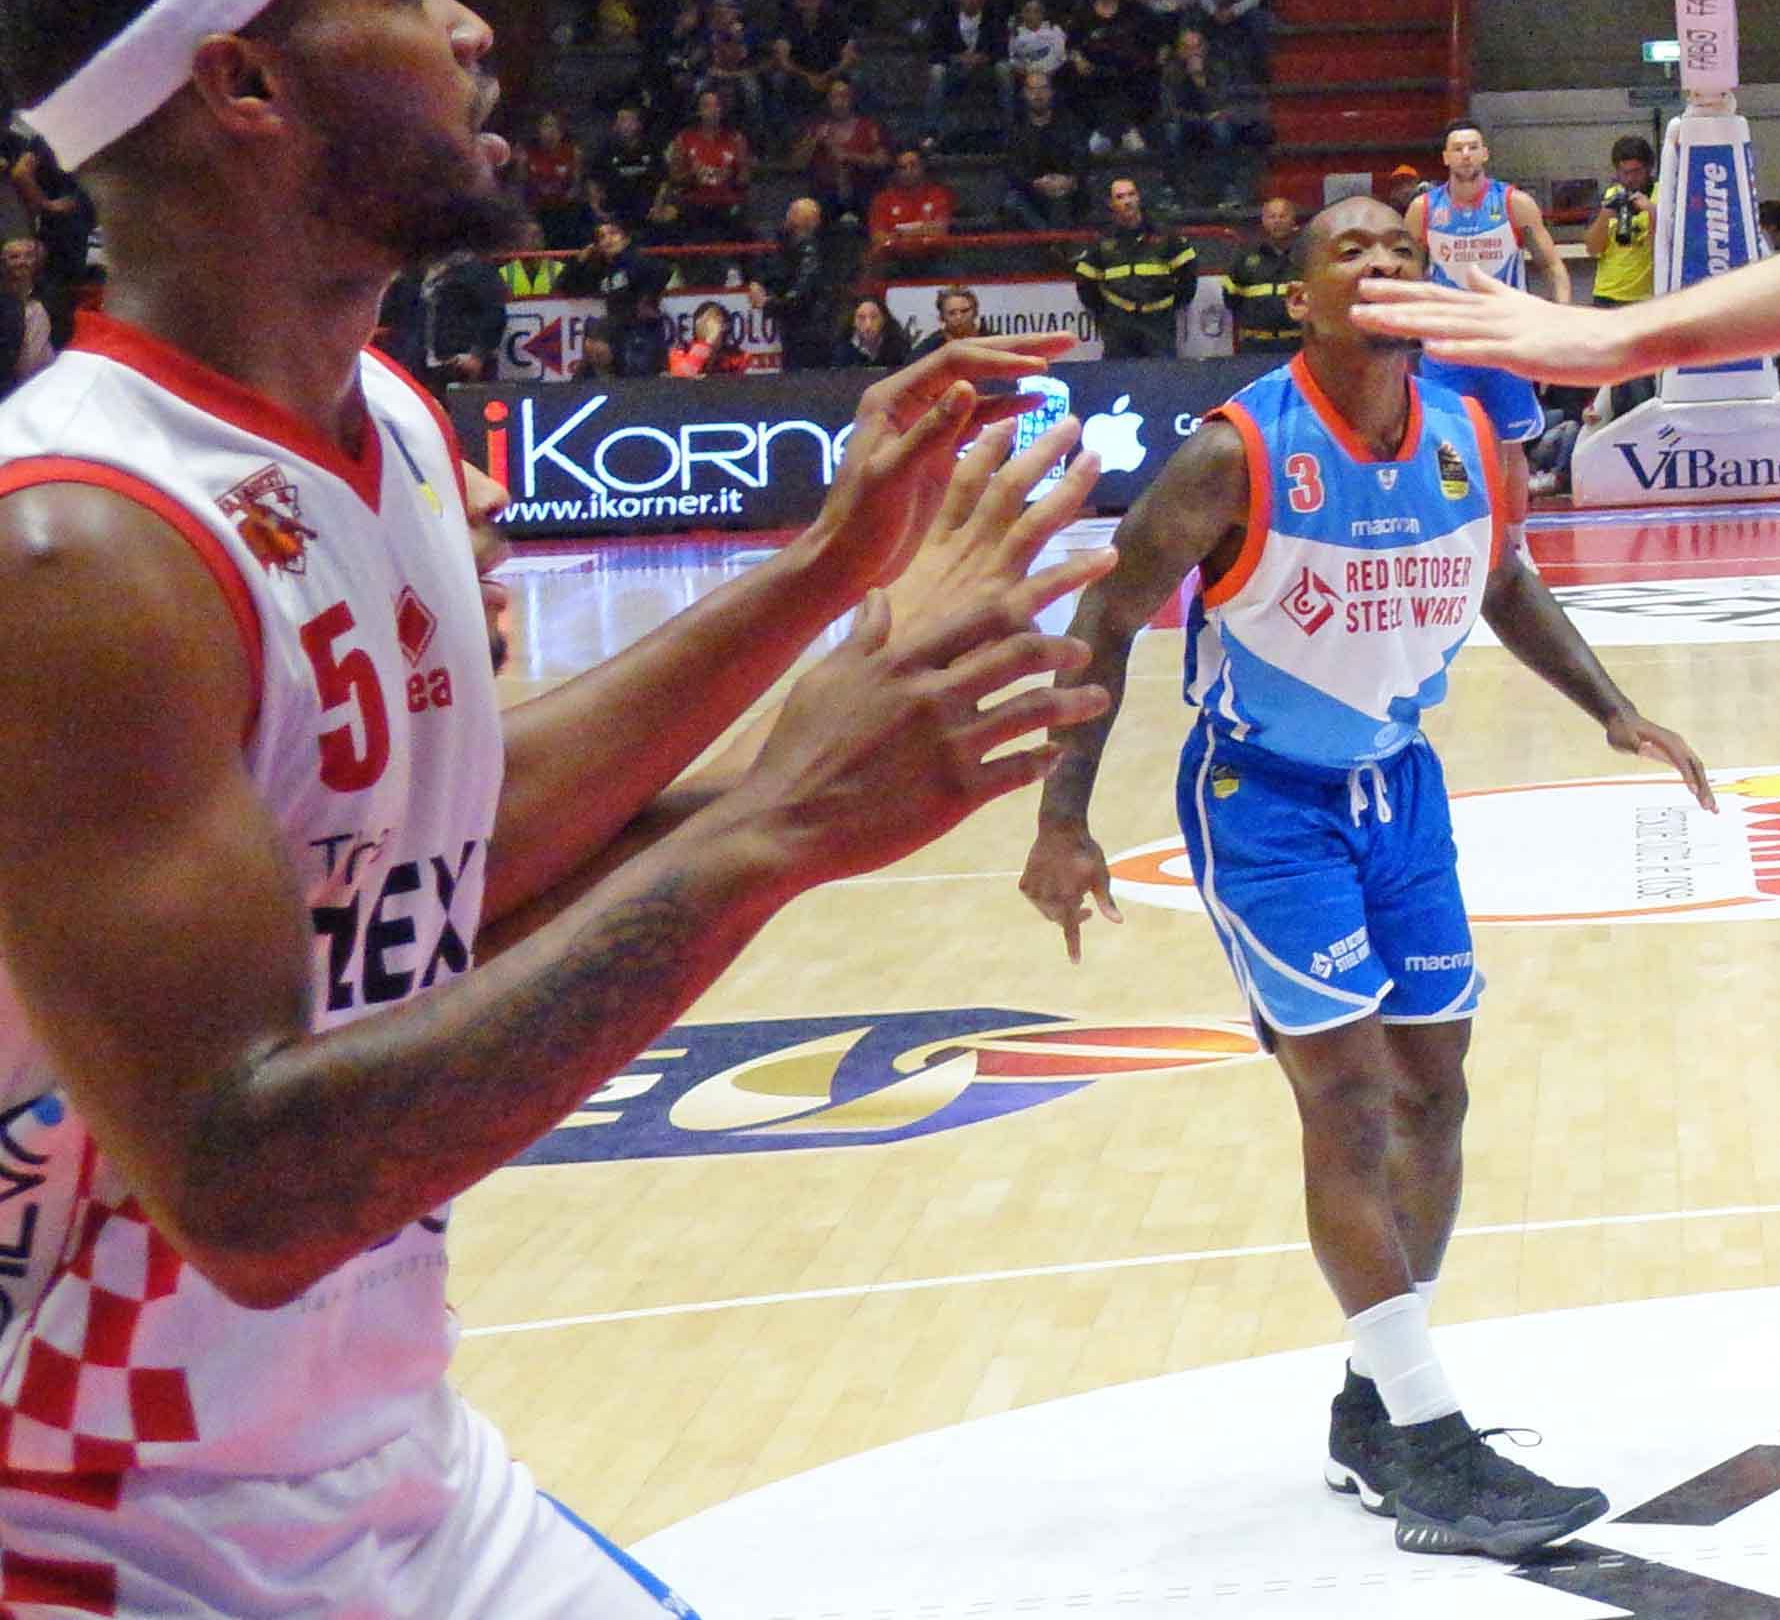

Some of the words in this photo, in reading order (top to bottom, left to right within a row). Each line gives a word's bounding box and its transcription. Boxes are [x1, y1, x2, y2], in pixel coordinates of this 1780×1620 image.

[1284, 451, 1326, 514] 3
[1351, 516, 1420, 538] macron
[1345, 558, 1390, 593] RED
[1394, 555, 1473, 590] OCTOBER
[1410, 595, 1468, 629] WRKS
[299, 599, 391, 794] 5
